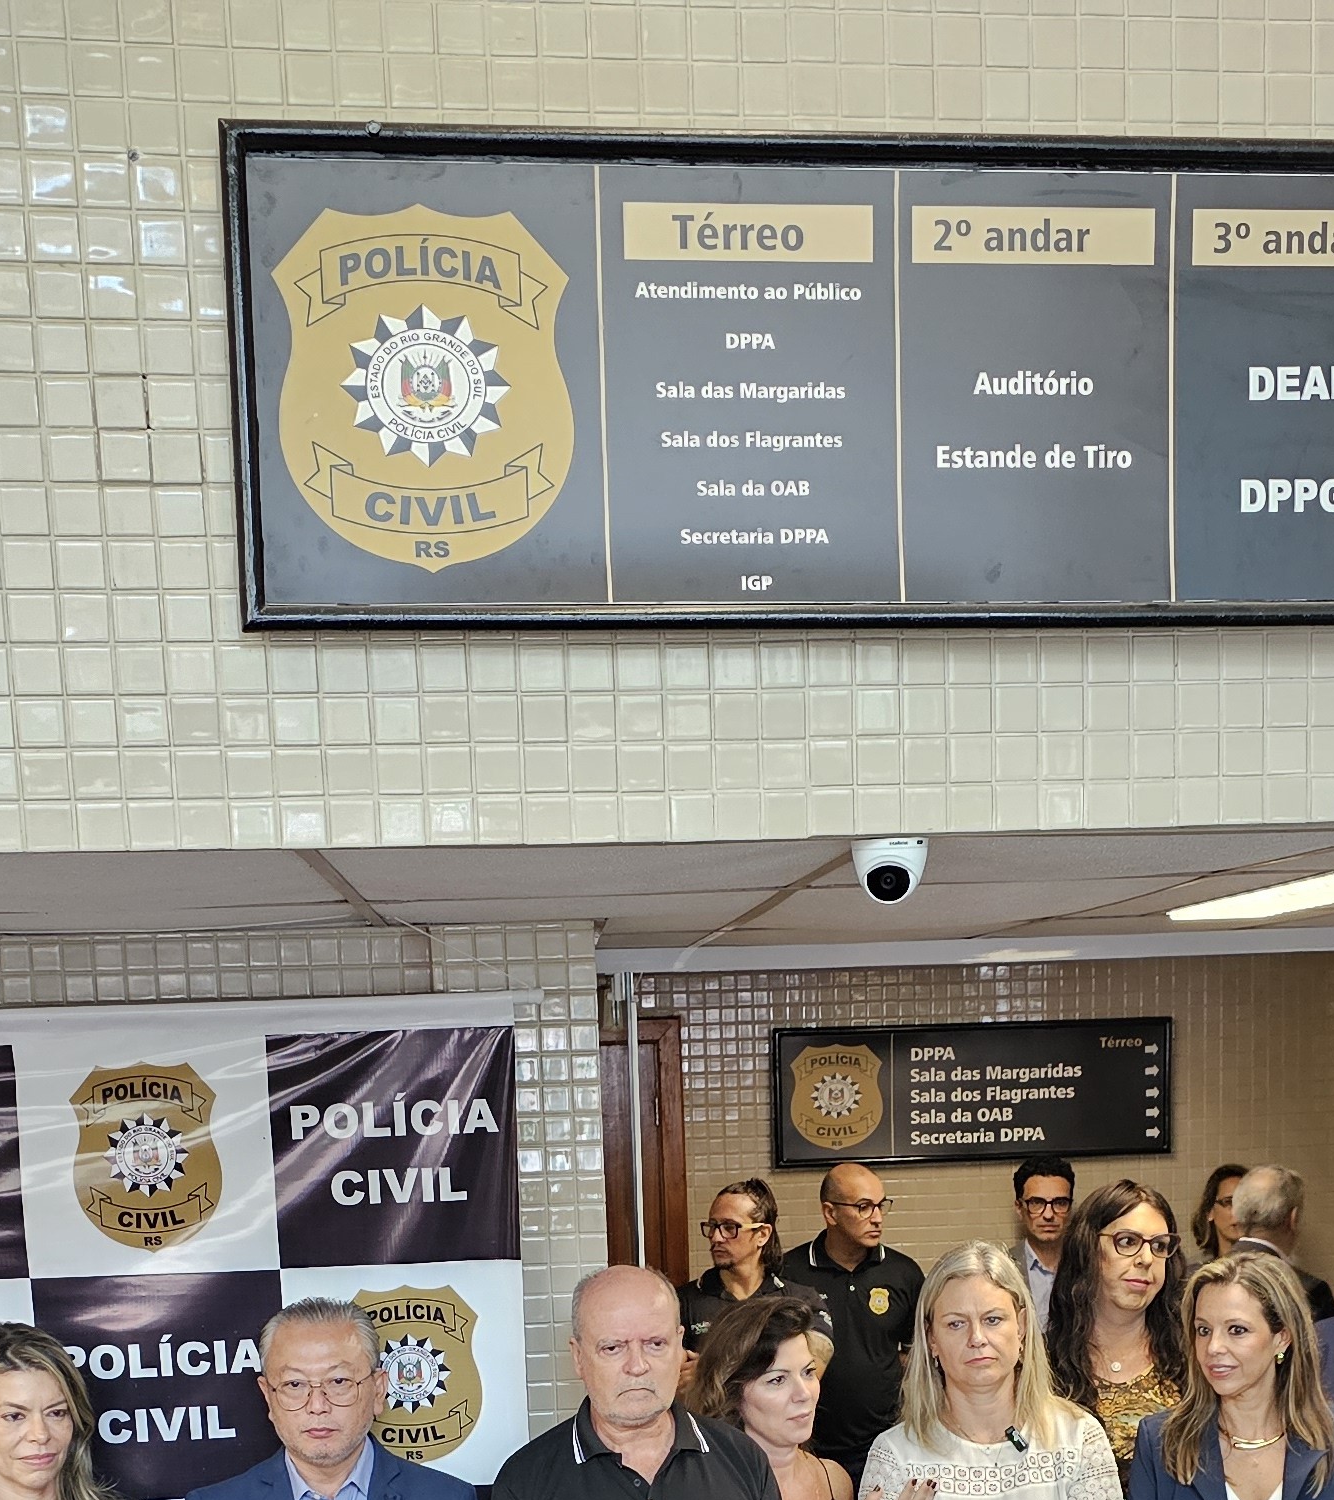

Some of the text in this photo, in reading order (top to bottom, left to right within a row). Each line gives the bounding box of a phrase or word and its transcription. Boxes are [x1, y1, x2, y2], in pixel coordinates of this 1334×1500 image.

[671, 211, 804, 252] Térreo
[983, 217, 1091, 253] andar
[338, 237, 503, 291] POLÍCIA
[634, 281, 862, 301] Atendimento ao Público
[725, 332, 776, 350] DPPA
[371, 333, 482, 400] ESTADO DO RIO GRANDE DO SUL
[655, 381, 846, 404] Sala das Margaridas
[972, 369, 1094, 396] Auditório
[388, 418, 466, 440] POLÍCIA CIVIL
[660, 430, 843, 452] Sala dos Flagrantes
[936, 443, 1133, 469] Estande de Tiro
[696, 479, 810, 497] Sala da OAB
[364, 491, 497, 527] CIVIL
[680, 527, 830, 545] Secretaria DPPA
[414, 540, 450, 559] RS
[740, 575, 773, 591] IGP
[1098, 1033, 1143, 1051] Térreo
[809, 1052, 862, 1070] POLÍCIA
[910, 1046, 956, 1062] DPPA
[910, 1062, 1083, 1083] Sala das Margaridas
[101, 1077, 184, 1104] POLÍCIA
[910, 1085, 1076, 1104] Sala dos Flagrantes
[289, 1092, 500, 1141] POLÍCIA
[910, 1107, 1013, 1125] Sala da OAB
[815, 1123, 858, 1138] CIVIL
[910, 1126, 1046, 1146] Secretaria DPPA
[329, 1167, 468, 1207] CIVIL
[117, 1209, 186, 1229] CIVIL
[143, 1235, 163, 1247] RS
[97, 1405, 237, 1444] CIVIL
[381, 1425, 446, 1444] CIVIL
[405, 1449, 423, 1460] RS
